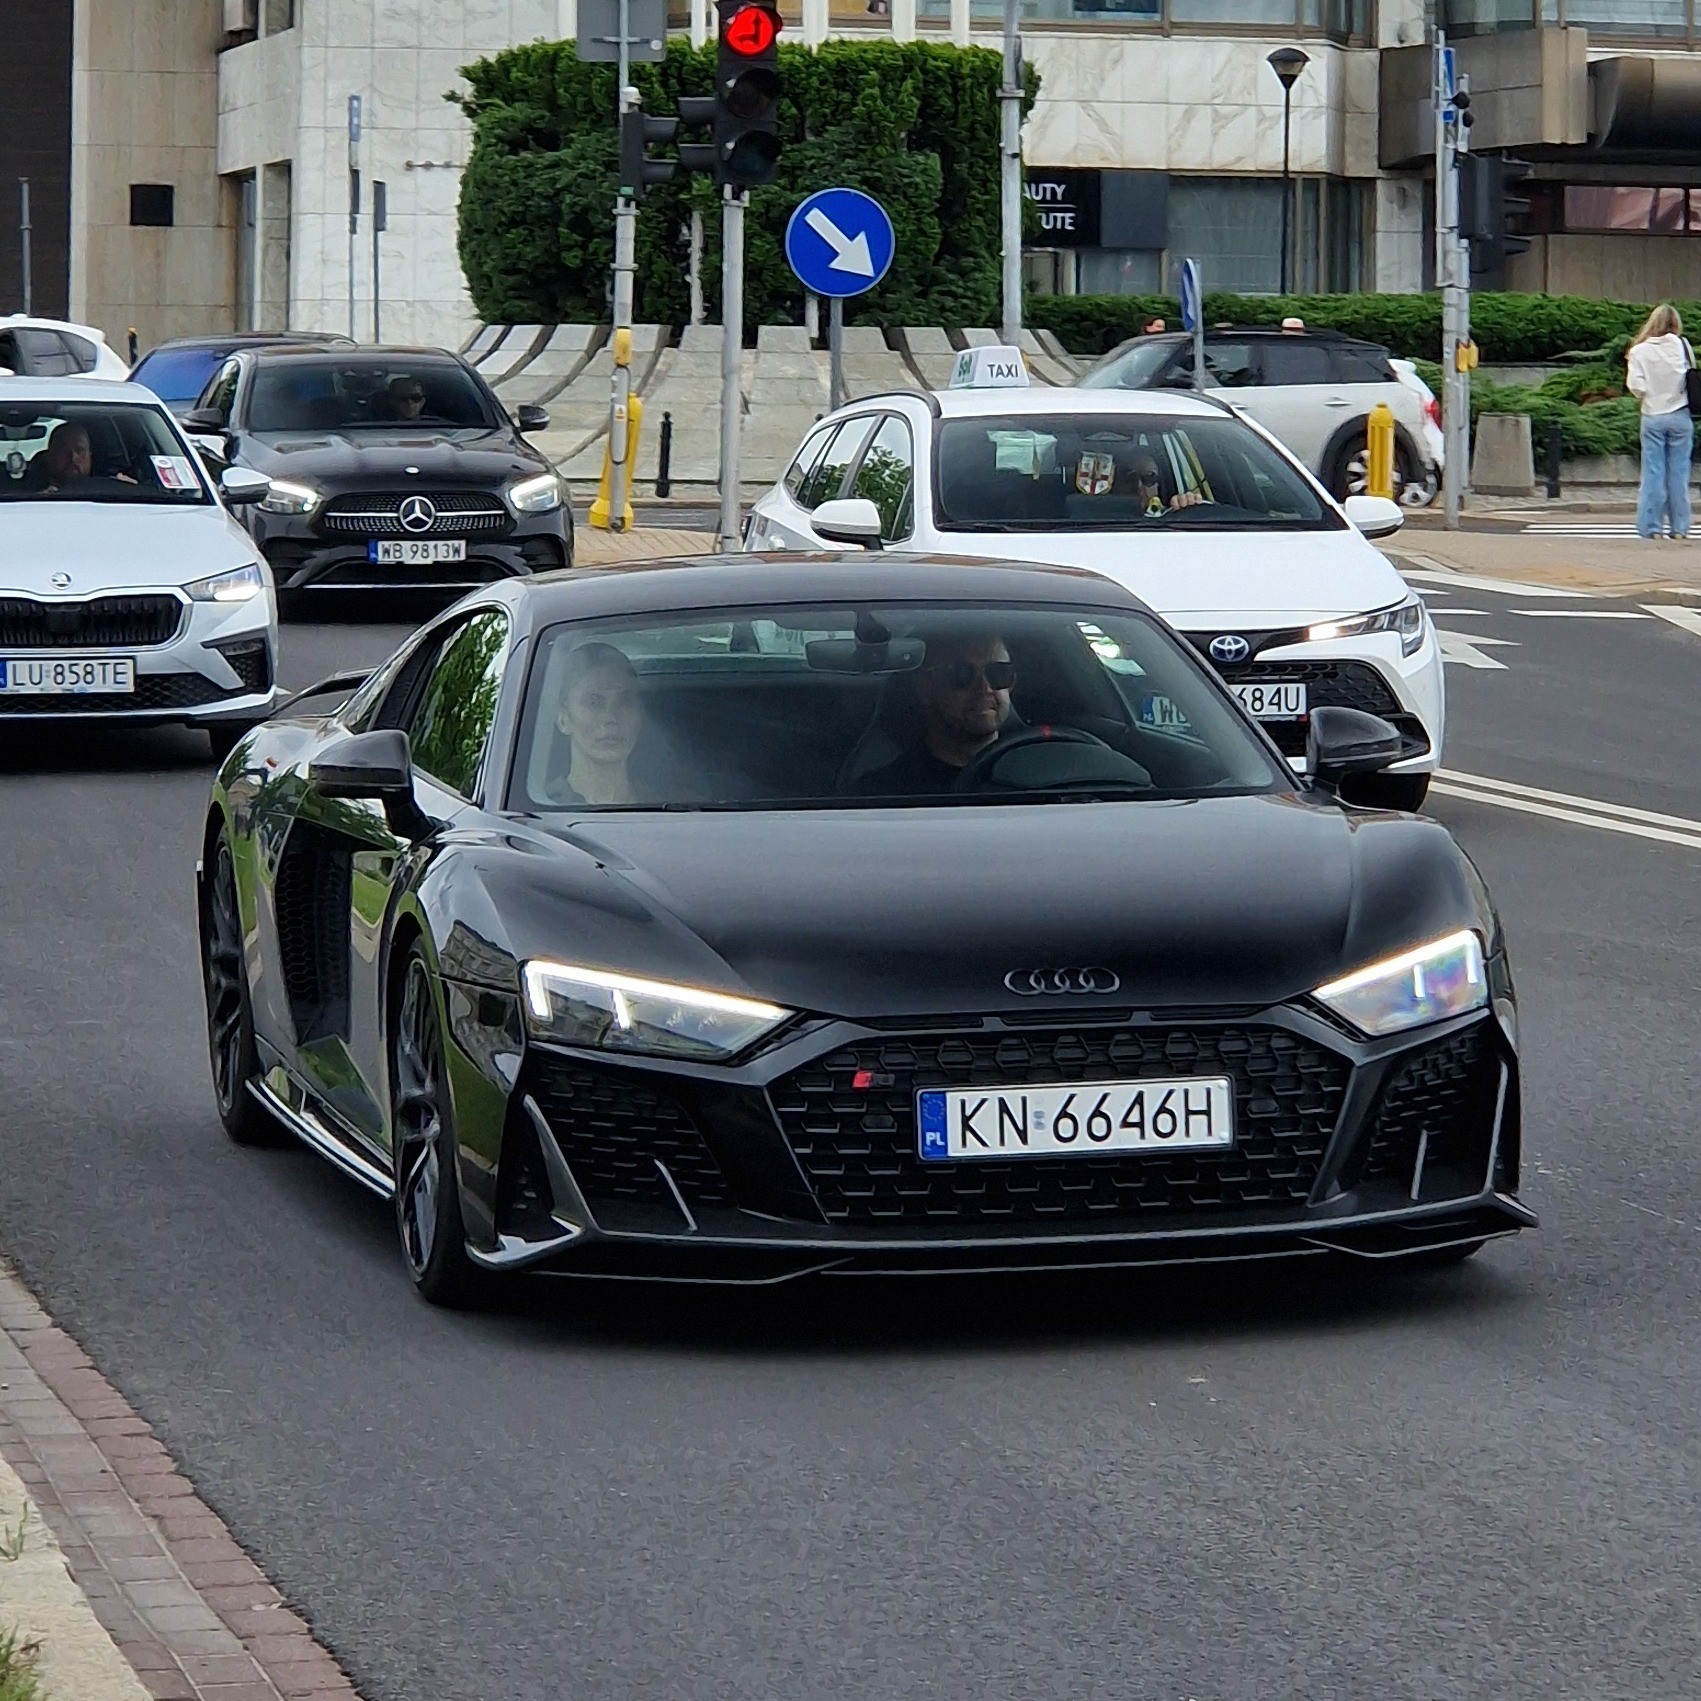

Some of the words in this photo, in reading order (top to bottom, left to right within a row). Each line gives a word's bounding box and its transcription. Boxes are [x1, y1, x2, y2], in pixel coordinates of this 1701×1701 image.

[987, 363, 1019, 379] TAXI
[381, 543, 403, 560] WB
[410, 543, 462, 560] 9813W
[12, 663, 43, 686] LU
[53, 662, 128, 686] 858TE
[959, 1095, 1029, 1149] KN
[1052, 1086, 1213, 1144] 6646H
[925, 1131, 946, 1147] PL
